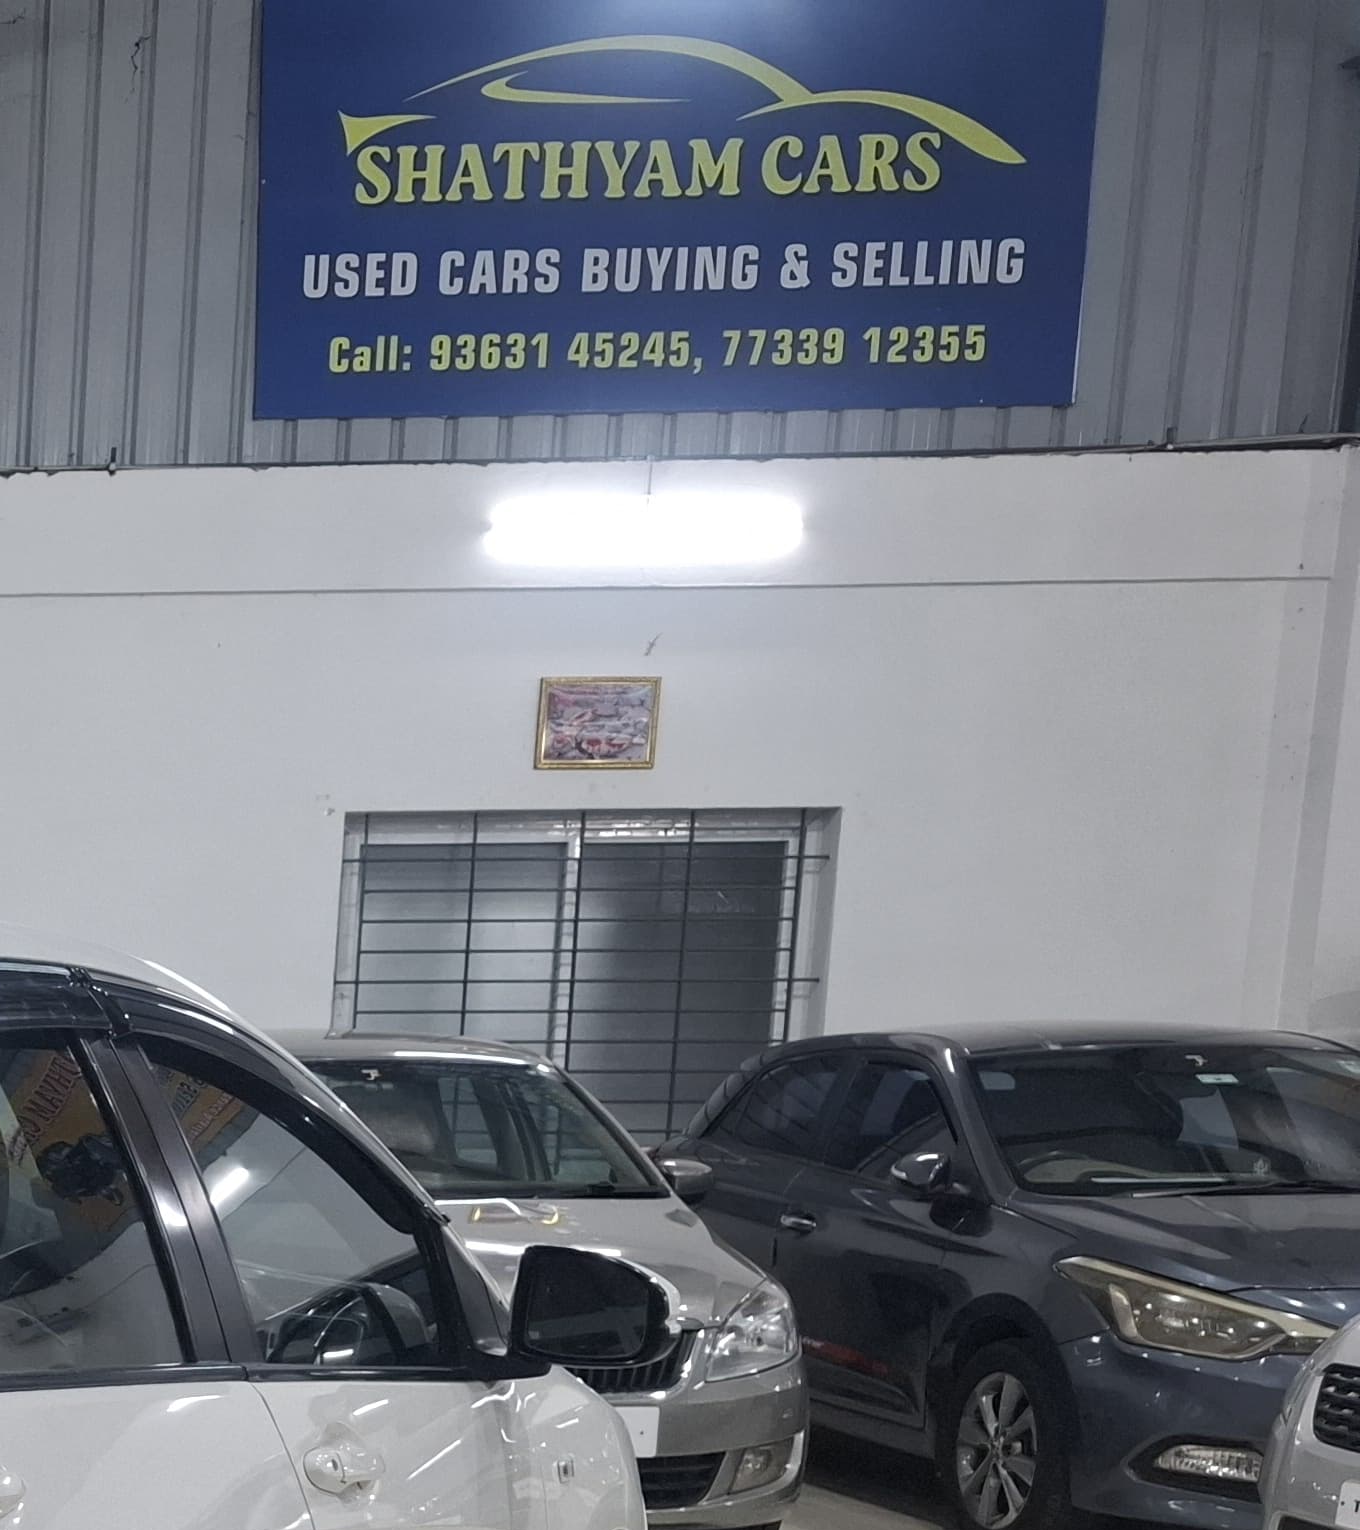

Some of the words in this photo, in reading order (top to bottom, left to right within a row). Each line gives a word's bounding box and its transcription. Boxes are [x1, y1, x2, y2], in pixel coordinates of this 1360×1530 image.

[353, 137, 742, 205] SHATHYAM
[760, 131, 944, 195] CARS
[302, 251, 419, 299] USED
[437, 248, 560, 296] CARS
[581, 244, 759, 292] BUYING
[779, 242, 811, 289] &
[831, 238, 1026, 288] SELLING
[328, 336, 413, 374] Call:
[429, 332, 550, 371] 93631
[566, 331, 703, 375] 45245,
[722, 328, 845, 368] 77339
[862, 324, 988, 365] 12355
